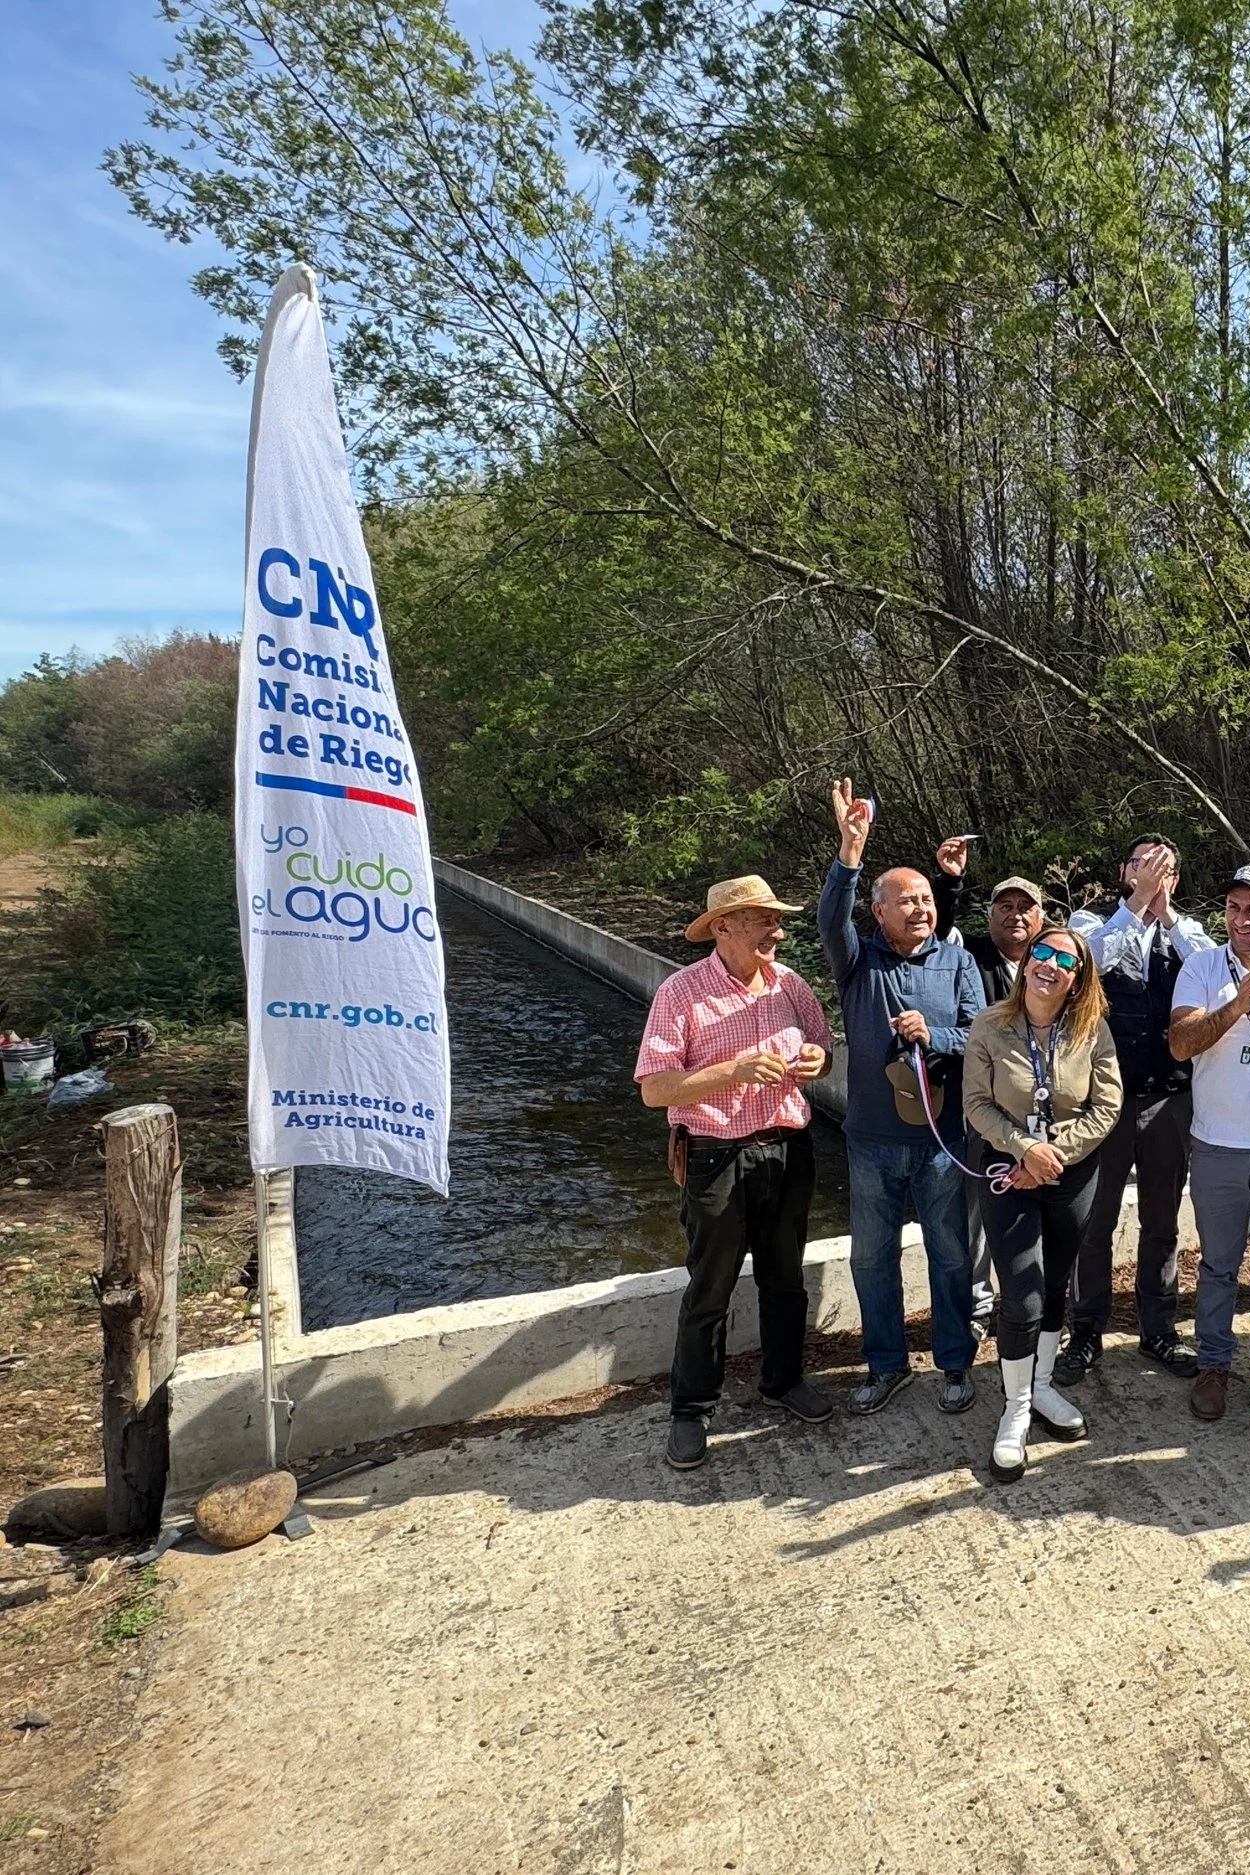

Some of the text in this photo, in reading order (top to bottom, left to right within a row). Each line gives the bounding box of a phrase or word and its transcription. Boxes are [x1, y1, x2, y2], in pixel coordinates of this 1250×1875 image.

[258, 548, 379, 661] CNR
[257, 634, 382, 693] Comisi
[258, 678, 405, 745] Naciona
[259, 724, 310, 757] de
[260, 823, 308, 853] yo
[286, 851, 413, 896] cuido
[252, 888, 281, 918] el
[271, 930, 310, 938] FOMENTO
[266, 1001, 438, 1035] cnr.gob.cl
[271, 1090, 435, 1121] Ministerio de
[284, 1111, 426, 1140] Agricultura
